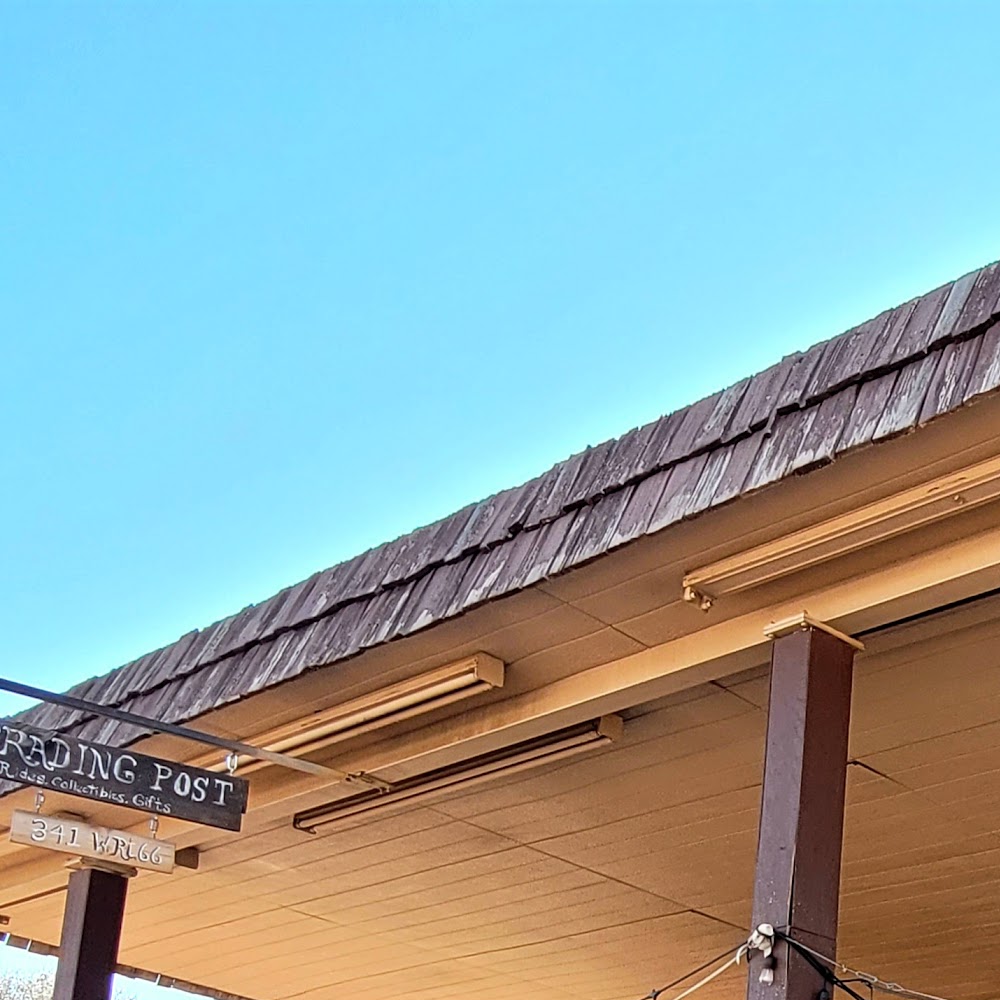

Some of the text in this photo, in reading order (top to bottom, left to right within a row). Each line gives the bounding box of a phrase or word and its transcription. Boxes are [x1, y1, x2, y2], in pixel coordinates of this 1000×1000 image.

[0, 726, 234, 806] RADING POST
[132, 793, 171, 813] Gifts
[31, 818, 80, 847] 341
